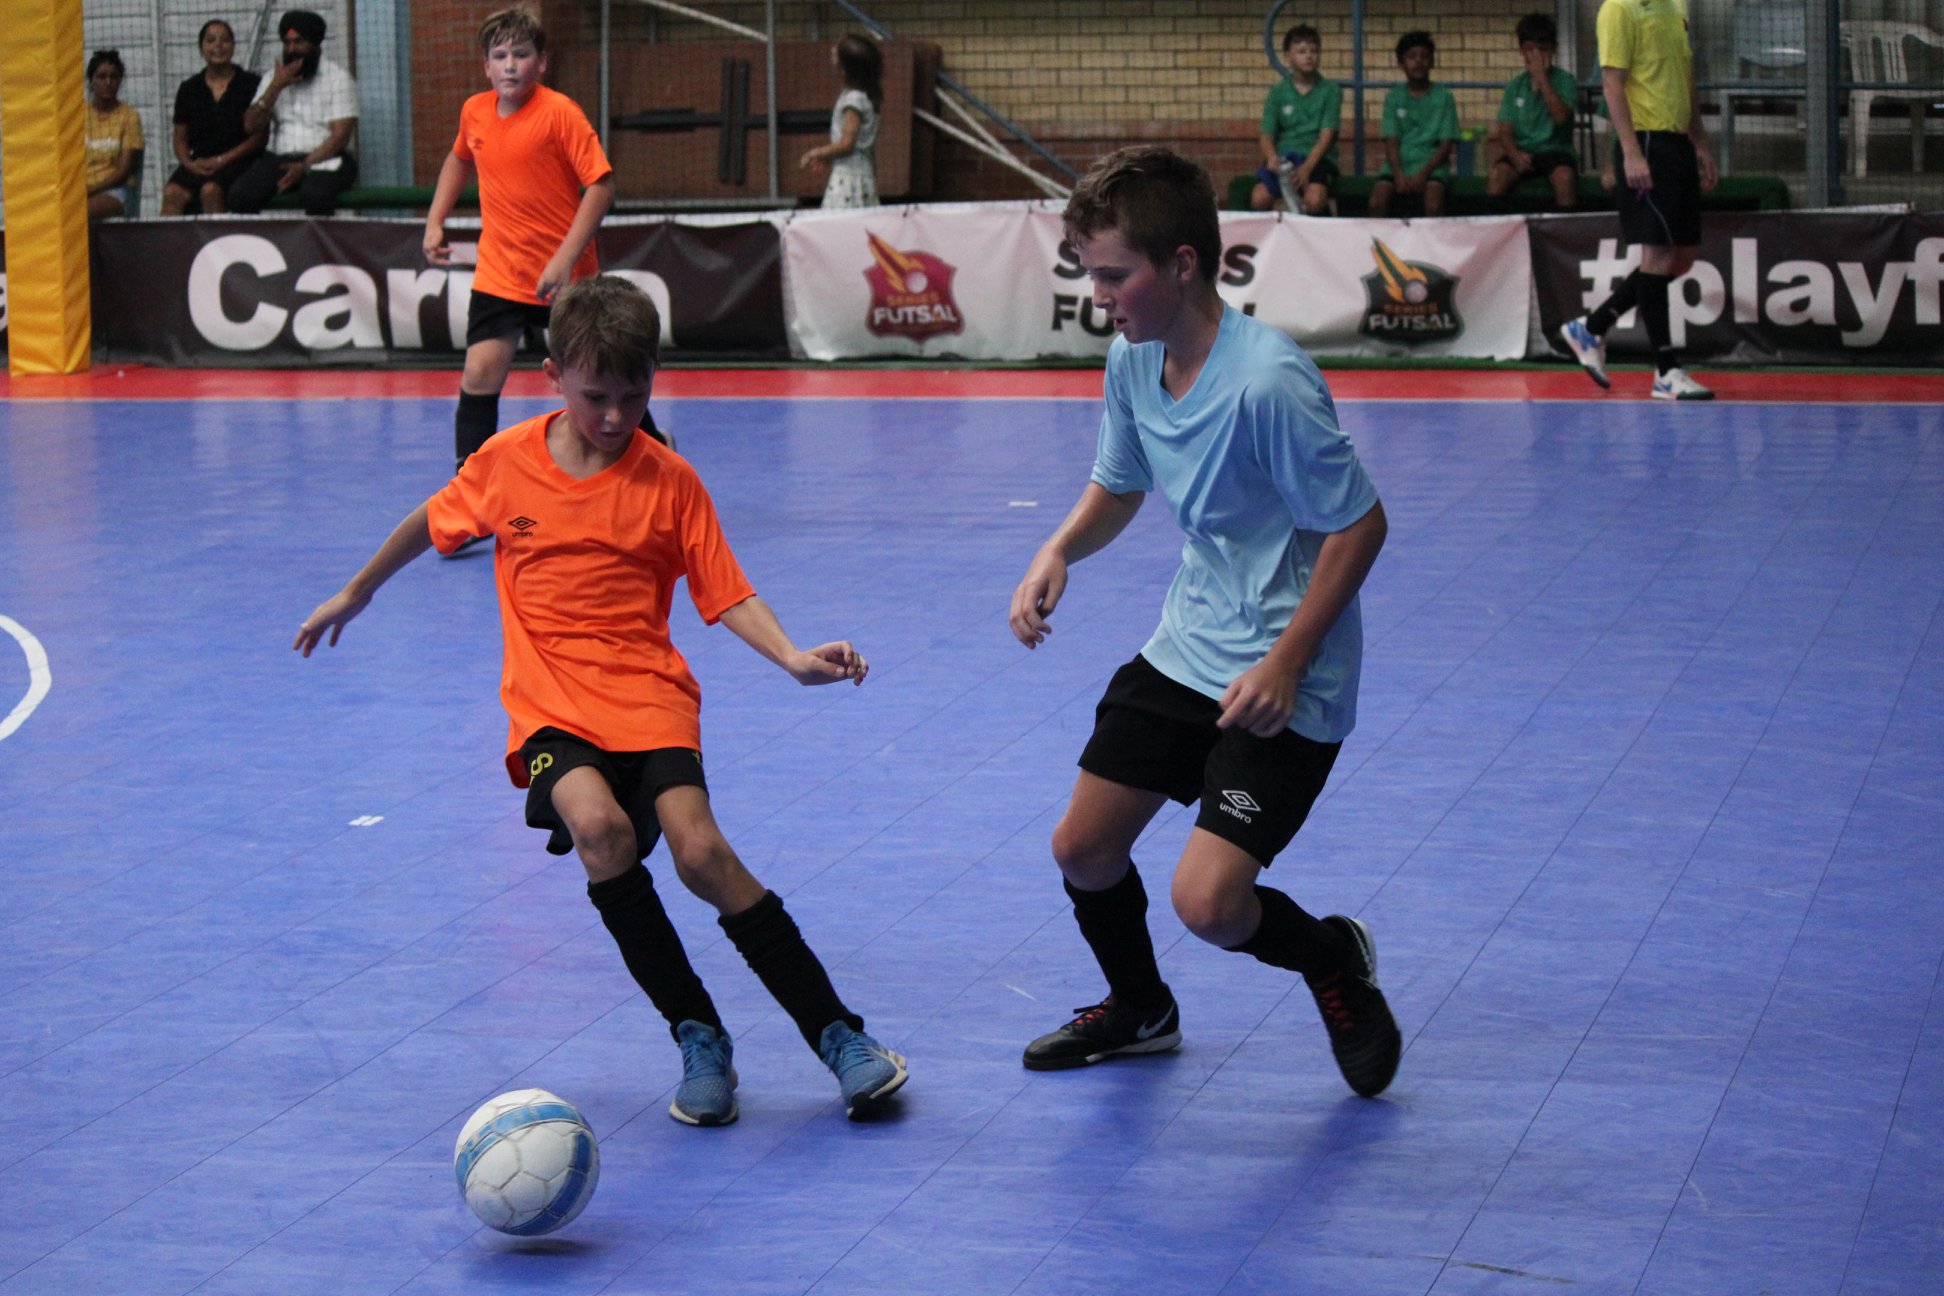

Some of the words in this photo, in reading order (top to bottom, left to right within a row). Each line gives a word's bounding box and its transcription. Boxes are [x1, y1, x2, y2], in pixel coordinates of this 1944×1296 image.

[873, 304, 957, 326] FUTSAL
[1369, 312, 1456, 330] FUTSAL
[1219, 802, 1252, 824] umbro
